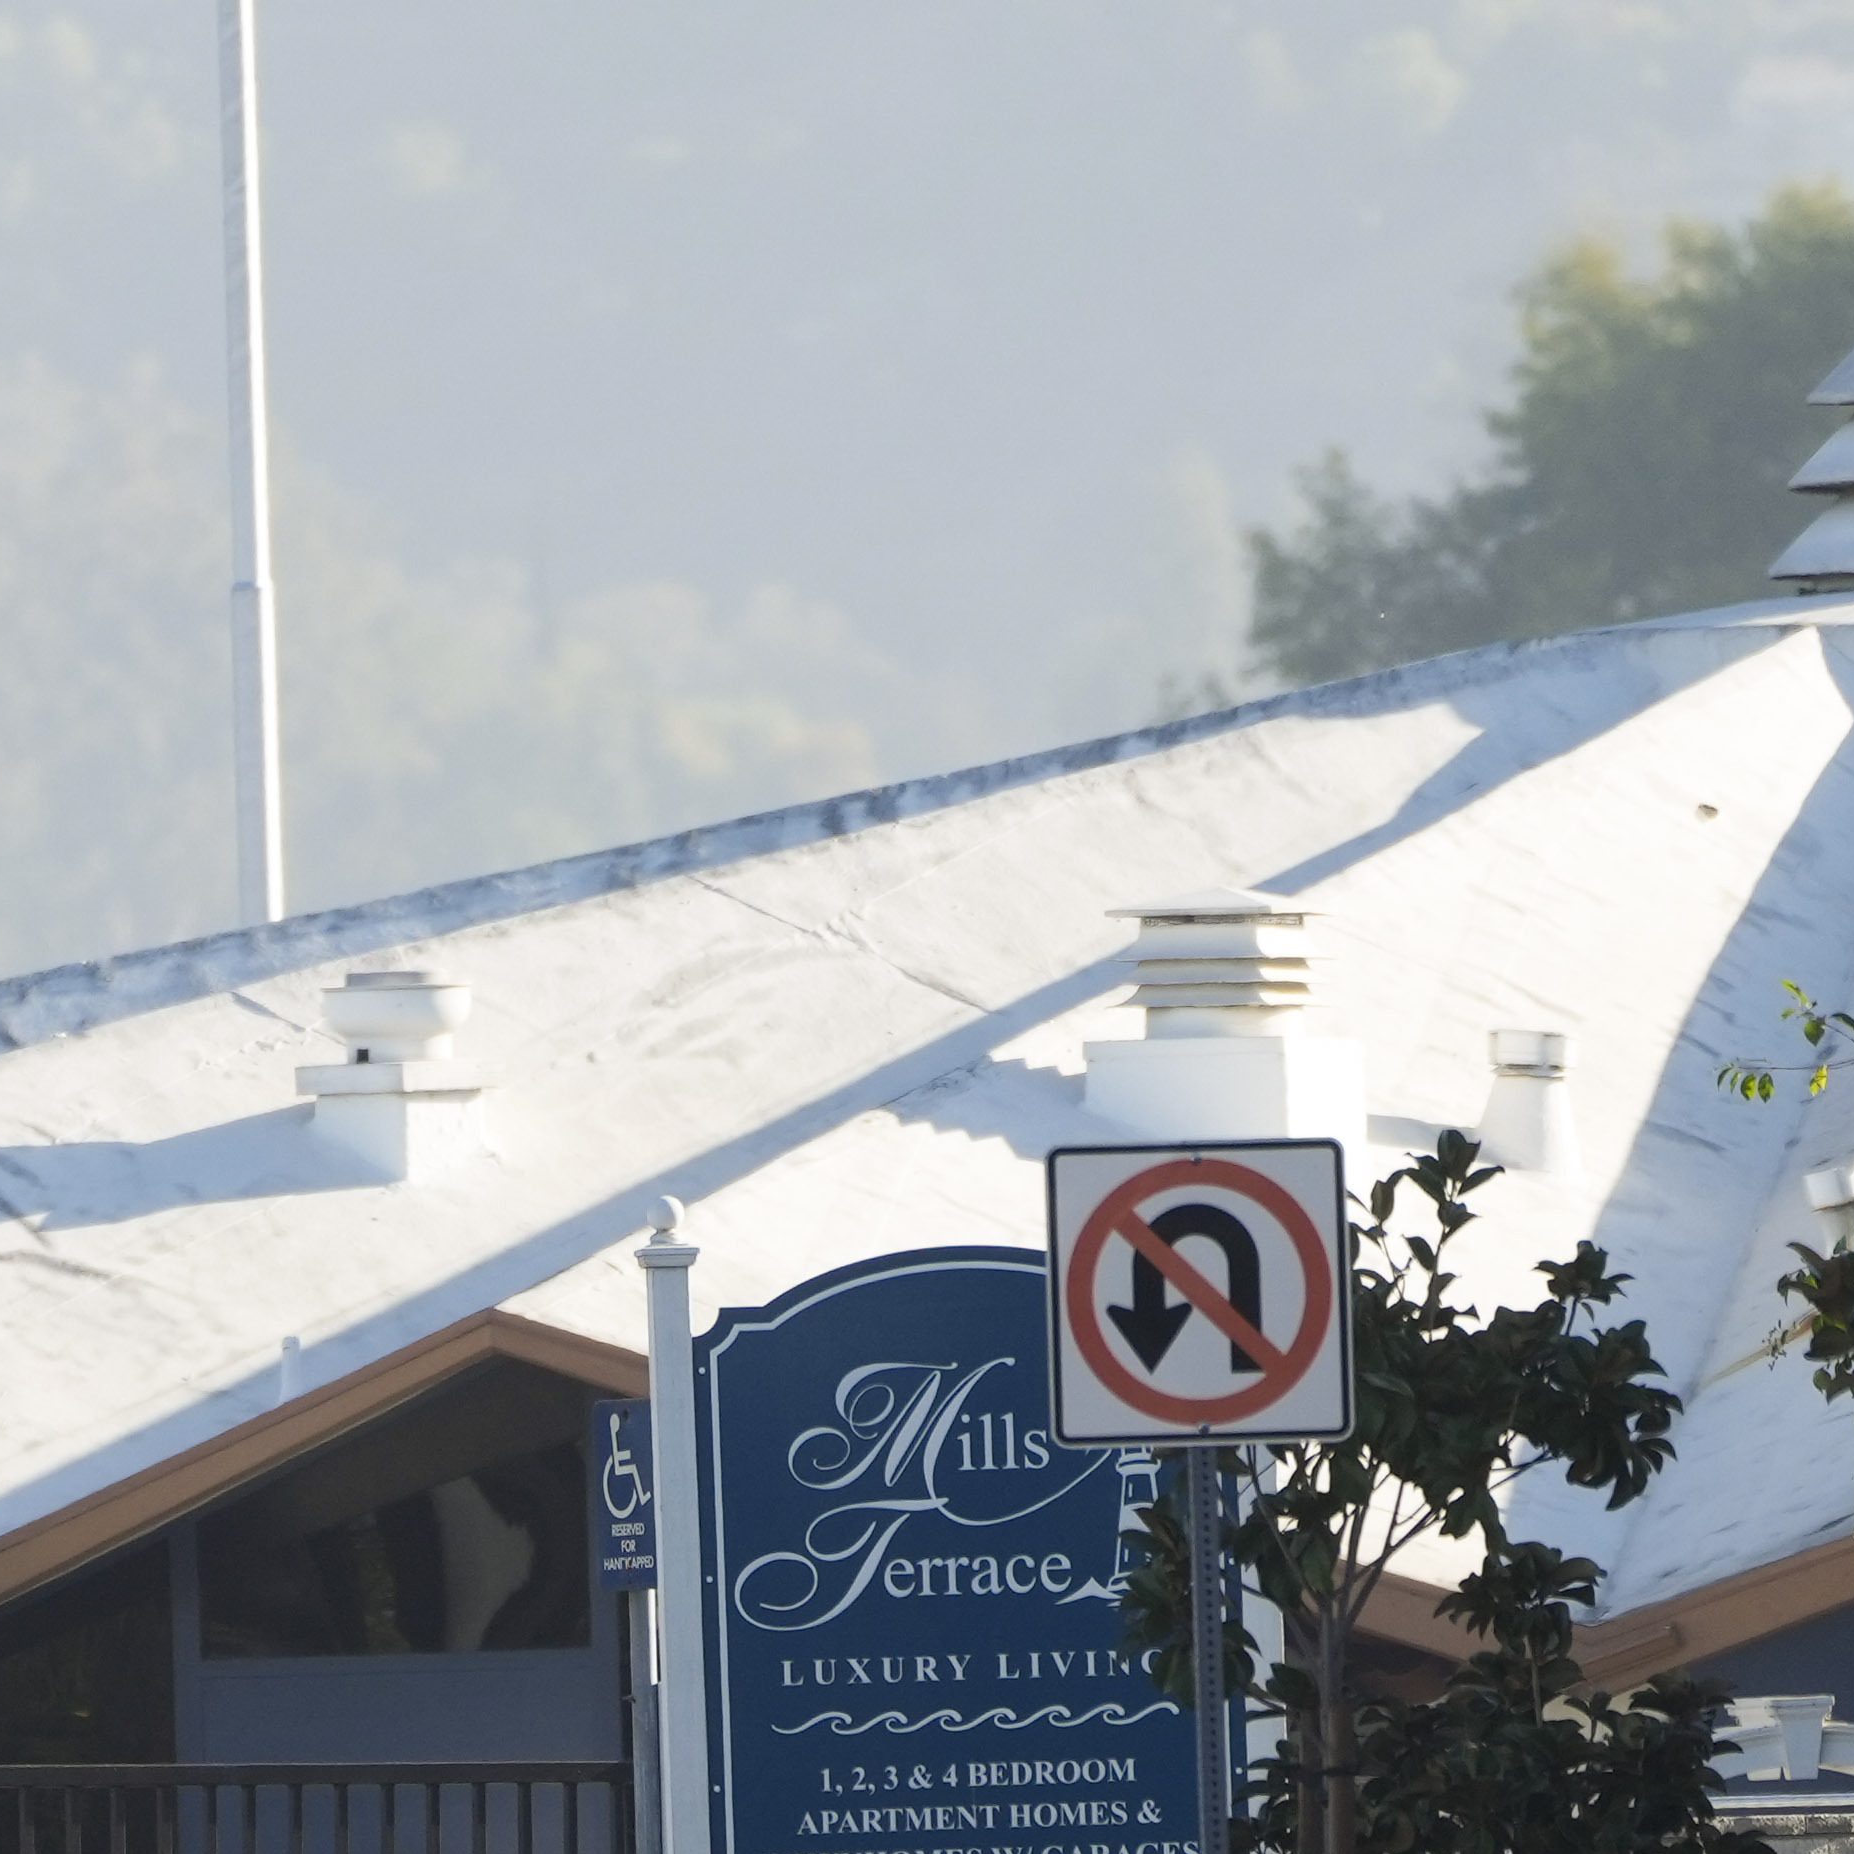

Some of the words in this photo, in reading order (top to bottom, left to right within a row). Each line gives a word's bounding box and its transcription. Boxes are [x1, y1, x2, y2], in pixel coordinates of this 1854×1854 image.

[788, 1357, 1051, 1500] Mills
[611, 1522, 645, 1537] RESERVED
[621, 1540, 636, 1553] FOR
[734, 1497, 1072, 1630] Terrace
[781, 1654, 972, 1687] LUXURY
[821, 1767, 843, 1797] 1,
[851, 1766, 876, 1795] 2,
[883, 1765, 899, 1791] 3
[908, 1764, 934, 1790] &
[942, 1762, 959, 1788] 4
[968, 1758, 1137, 1788] BEDROOM
[796, 1803, 1001, 1836] APARTMENT
[1009, 1800, 1129, 1829] HOMES
[1136, 1799, 1163, 1825] &
